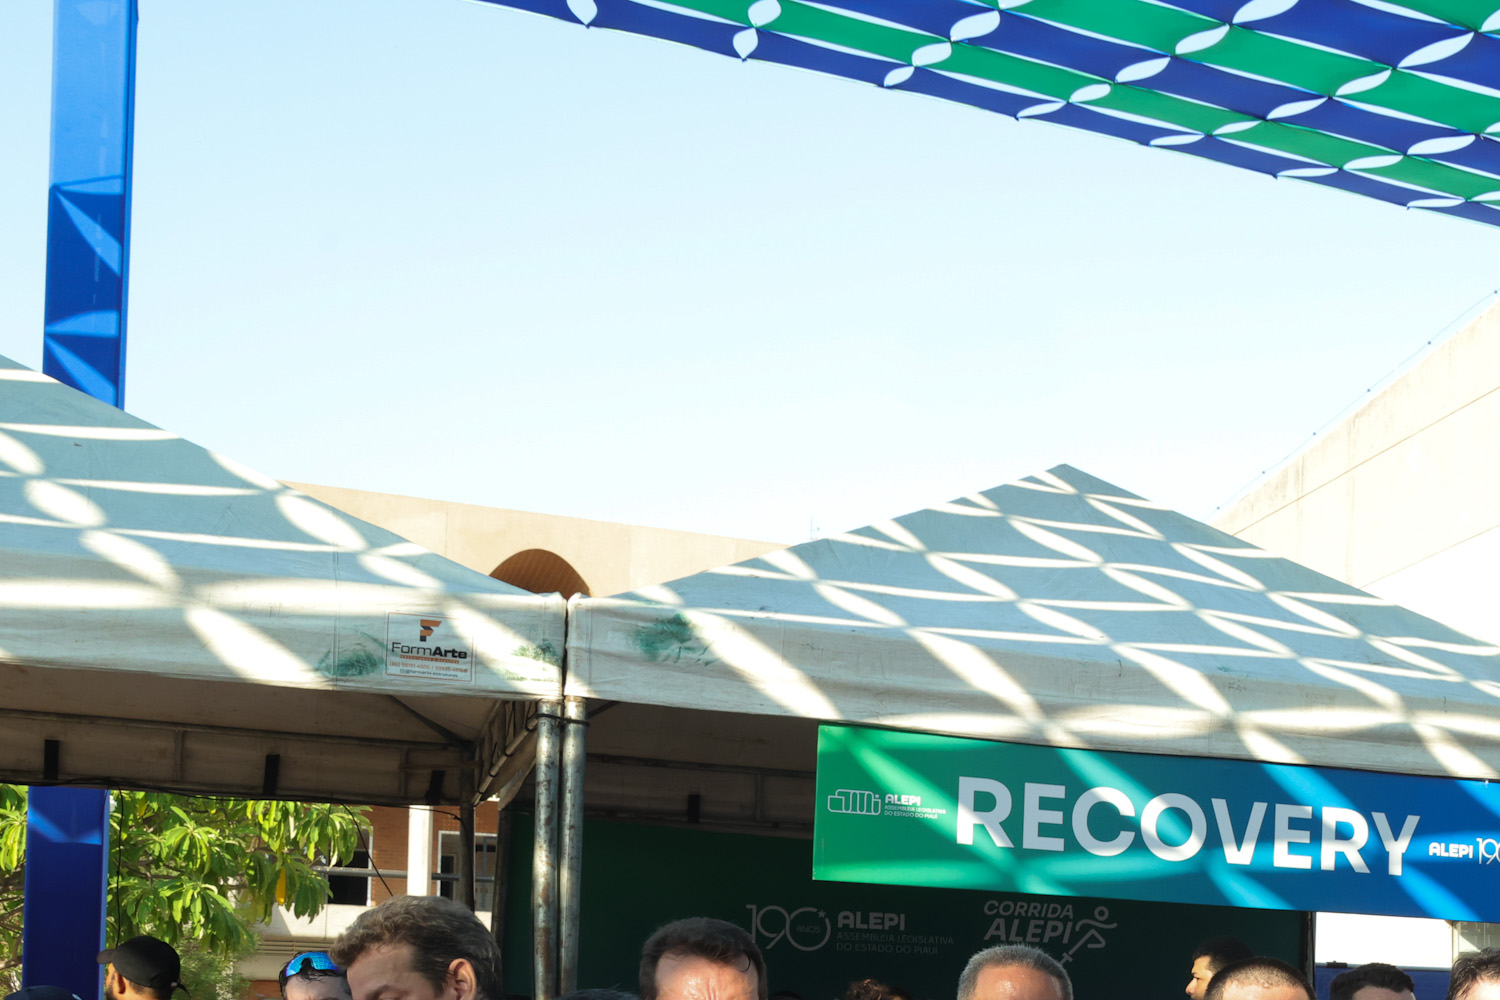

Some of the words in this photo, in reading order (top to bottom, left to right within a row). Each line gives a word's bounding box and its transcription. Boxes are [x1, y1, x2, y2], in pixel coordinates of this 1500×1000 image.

[391, 642, 468, 659] FormArte
[885, 794, 921, 806] ALEPI
[955, 775, 1420, 876] RECOVERY
[1428, 842, 1474, 859] ALEPI
[983, 900, 1075, 919] CORRIDA
[746, 904, 832, 951] 190
[837, 910, 906, 931] ALEPI
[837, 932, 896, 943] ASSEMBLEIA
[898, 934, 954, 945] LEGISLATIVA
[983, 918, 1074, 944] ALEPI
[837, 943, 852, 951] DO
[855, 943, 892, 953] ESTADO
[896, 945, 911, 953] DO
